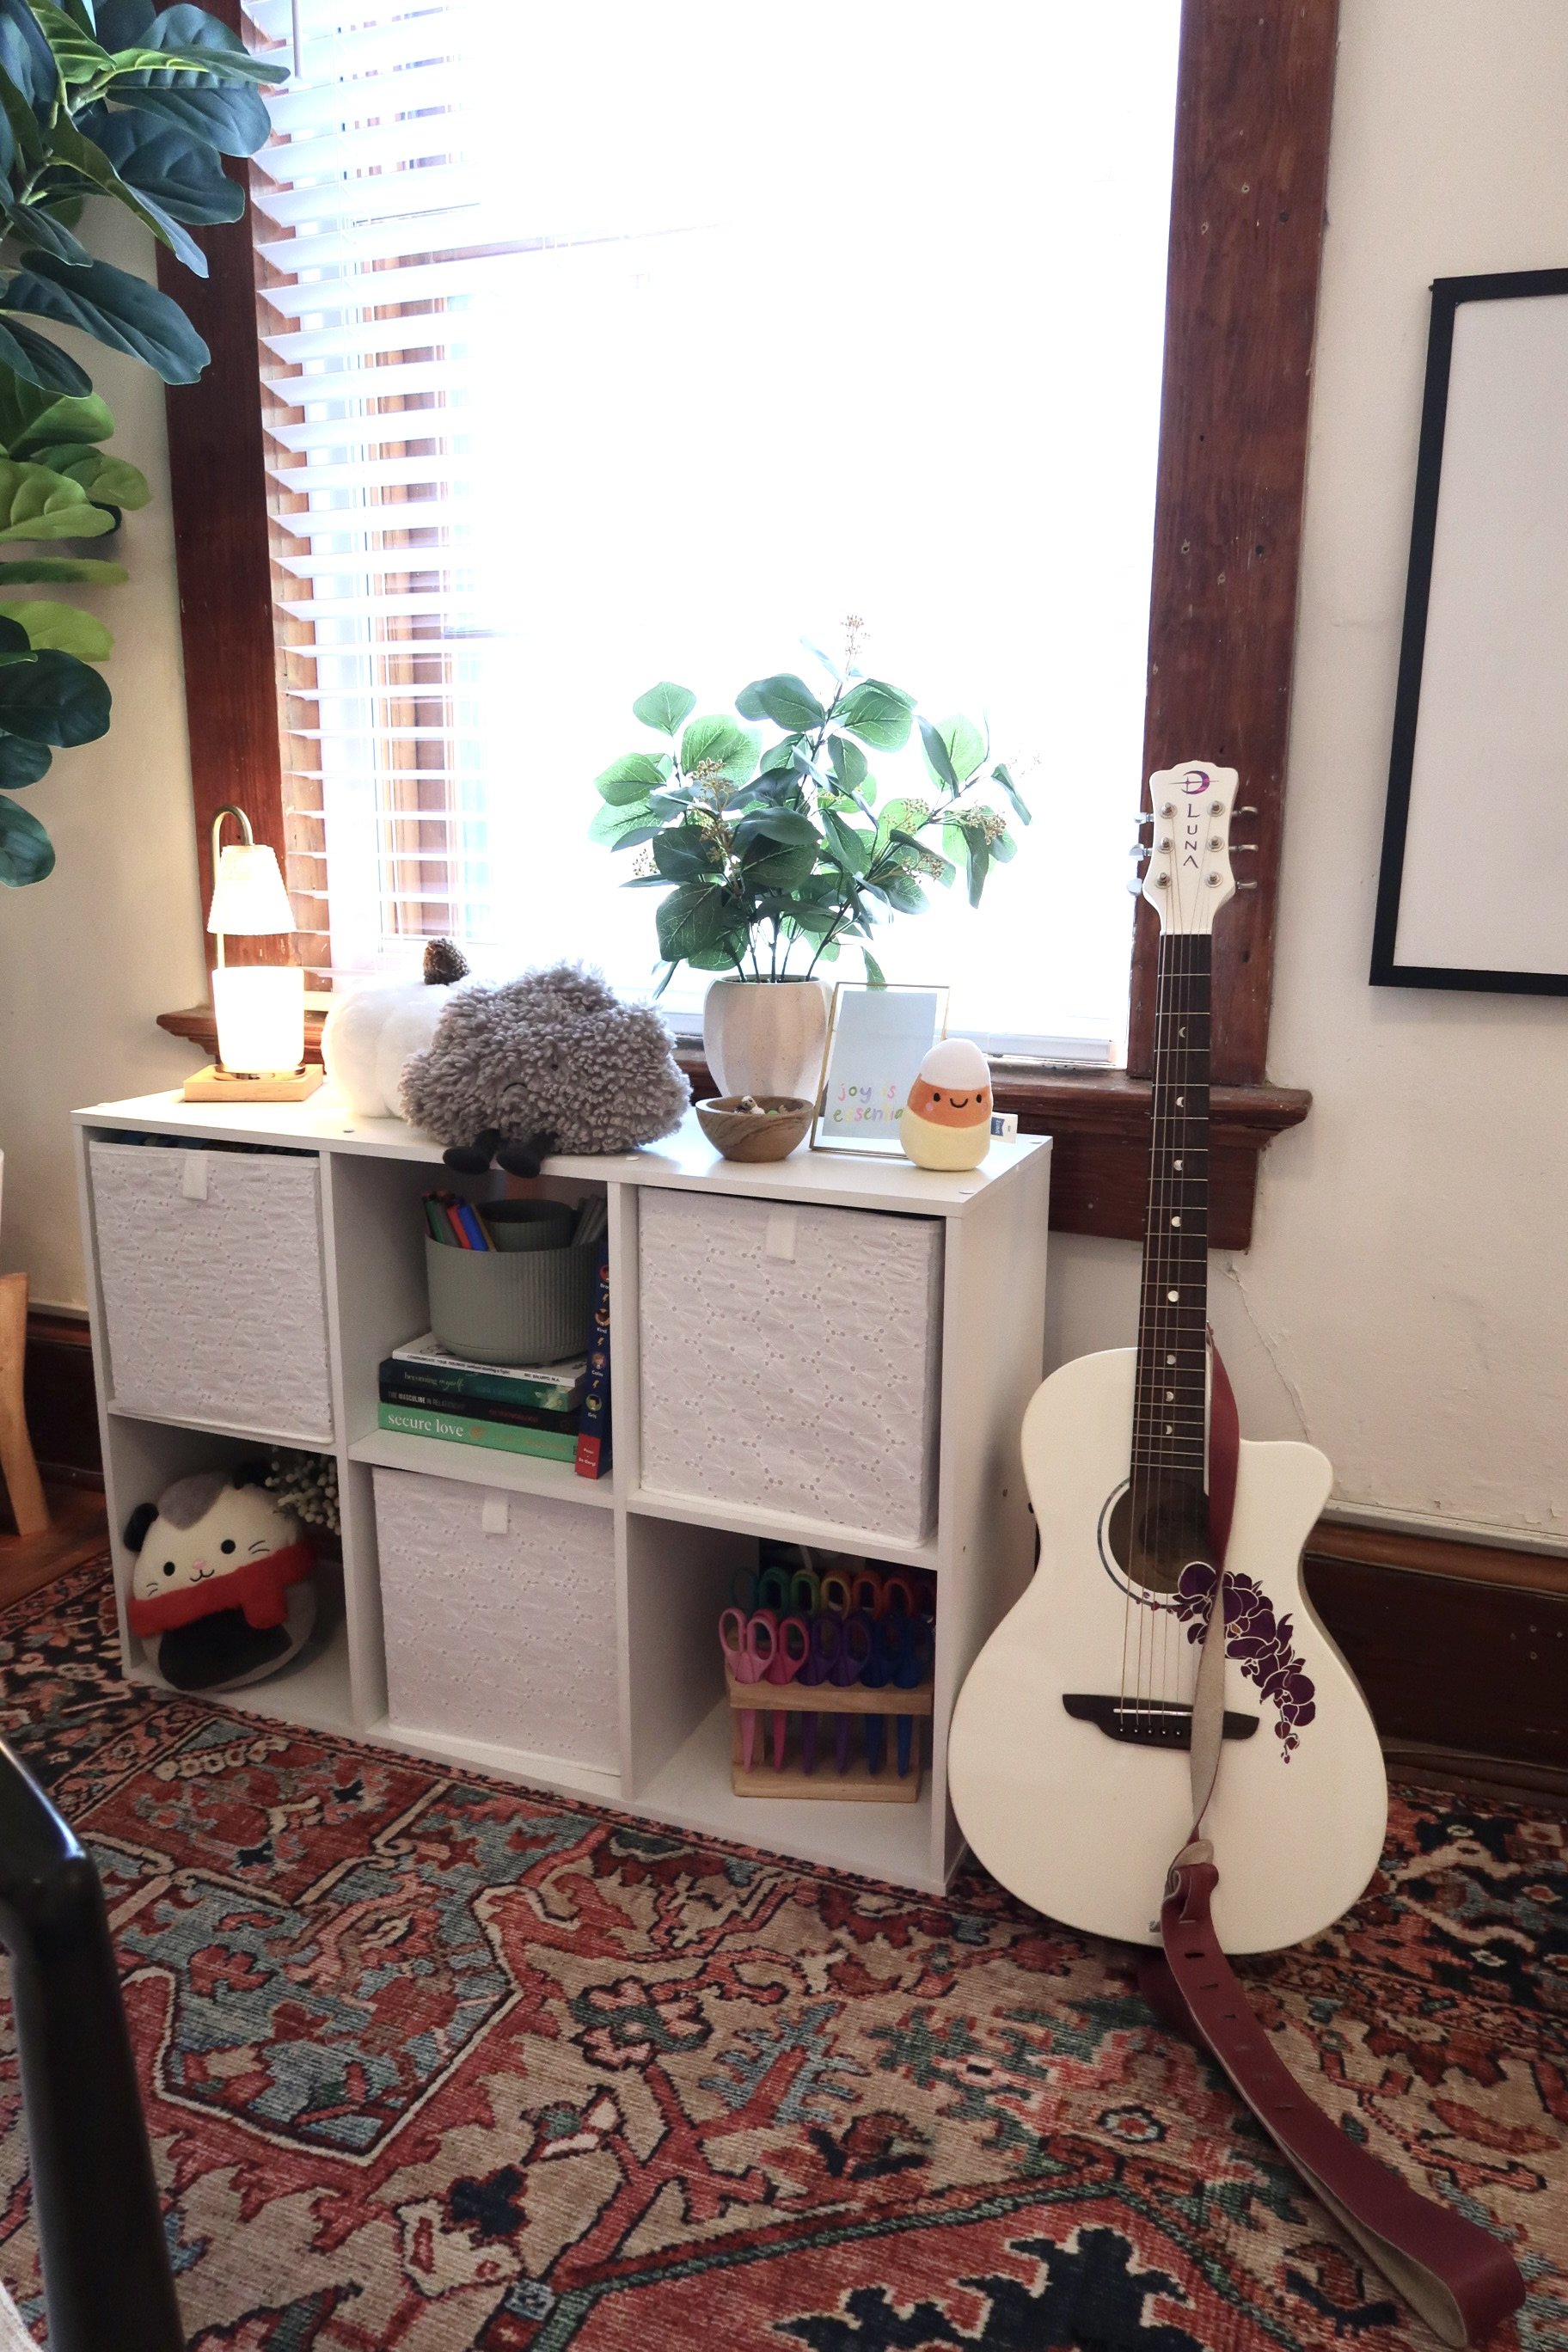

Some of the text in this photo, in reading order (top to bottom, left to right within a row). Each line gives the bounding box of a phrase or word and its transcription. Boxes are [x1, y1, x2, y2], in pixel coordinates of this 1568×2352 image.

[1183, 803, 1200, 869] LUNA
[838, 1082, 873, 1104] joy
[833, 1104, 904, 1123] essentia
[398, 1393, 426, 1404] MASCULINE
[388, 1414, 464, 1437] secure love
